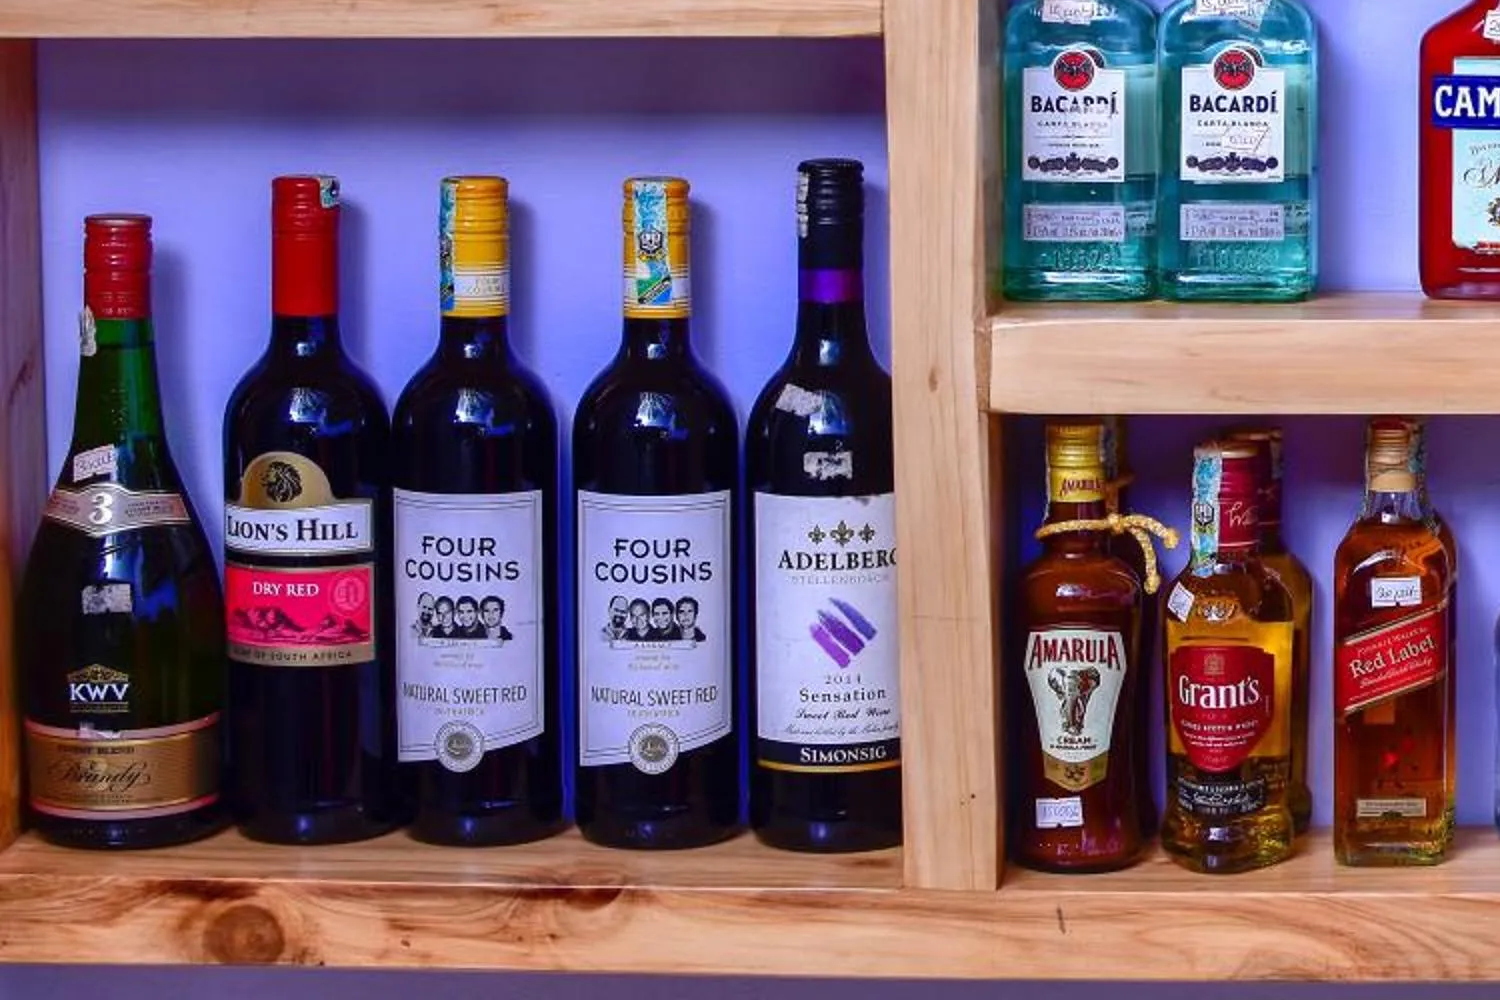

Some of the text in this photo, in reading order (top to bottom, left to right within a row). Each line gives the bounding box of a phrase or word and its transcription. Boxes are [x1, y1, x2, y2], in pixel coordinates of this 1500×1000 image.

[1189, 90, 1278, 113] BACARDÍ
[88, 492, 114, 525] 3
[226, 513, 359, 542] LION'S HILL
[421, 535, 497, 558] FOUR
[613, 537, 692, 560] FOUR
[404, 558, 520, 583] COUSINS
[594, 560, 713, 585] COUSINS
[252, 580, 320, 598] DRY RED
[1028, 634, 1123, 672] AMARULA
[1349, 633, 1437, 679] Red Label
[69, 682, 130, 702] KWV
[402, 681, 527, 706] NATURAL SWEET RED
[590, 684, 718, 708] NATURAL SWEET RED
[799, 687, 887, 703] Sensation
[1178, 674, 1261, 709] Grant's
[799, 745, 888, 763] SIMONSIG
